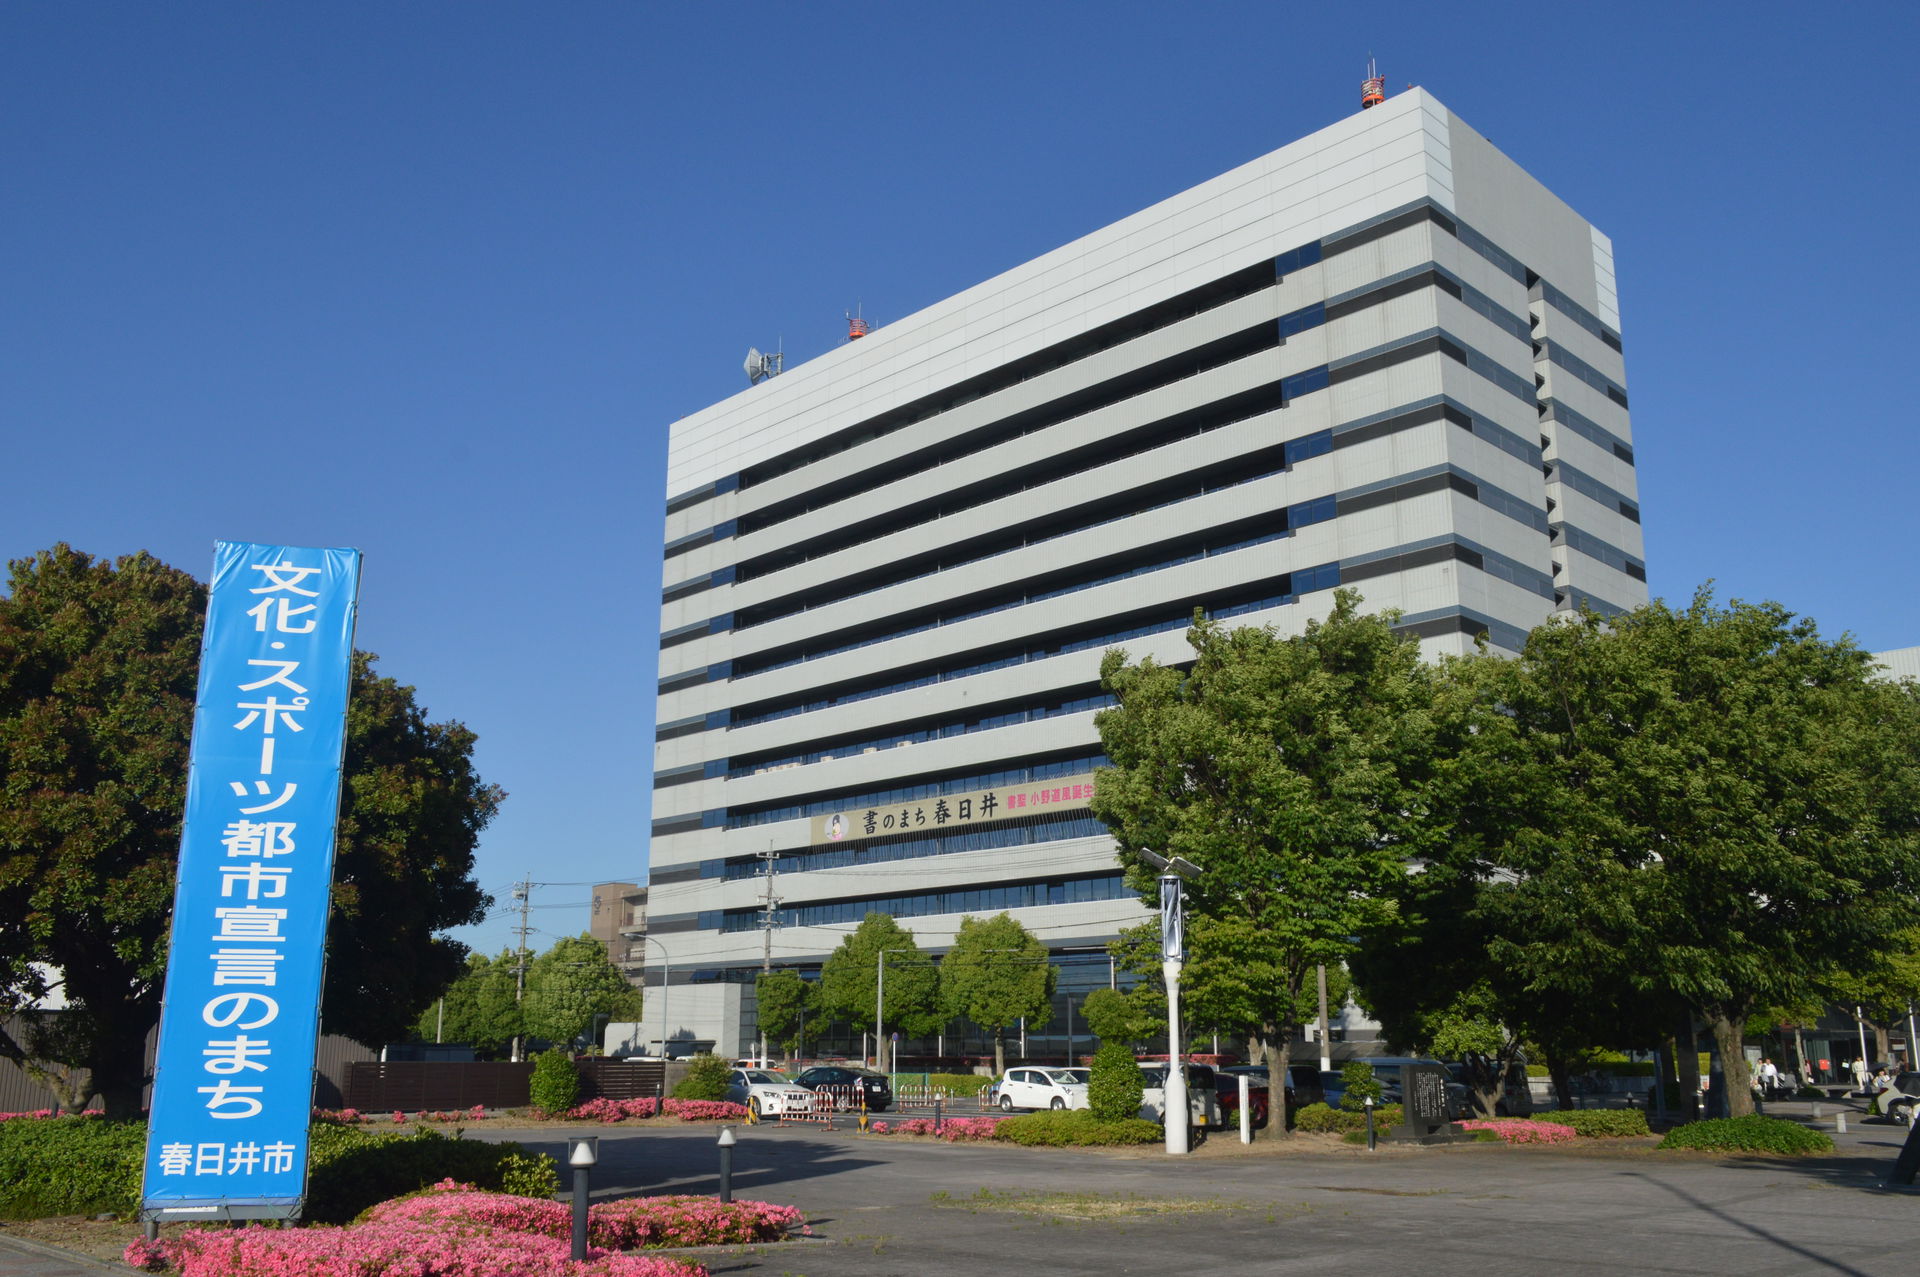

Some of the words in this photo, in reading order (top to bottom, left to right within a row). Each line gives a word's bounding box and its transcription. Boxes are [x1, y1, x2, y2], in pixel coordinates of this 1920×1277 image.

[863, 792, 998, 835] 書のまち春日井
[1031, 783, 1096, 806] 小野道風誕生
[198, 558, 322, 1119] 文化・スポーツ都市宣言のまち
[159, 1140, 296, 1176] 春日井市
